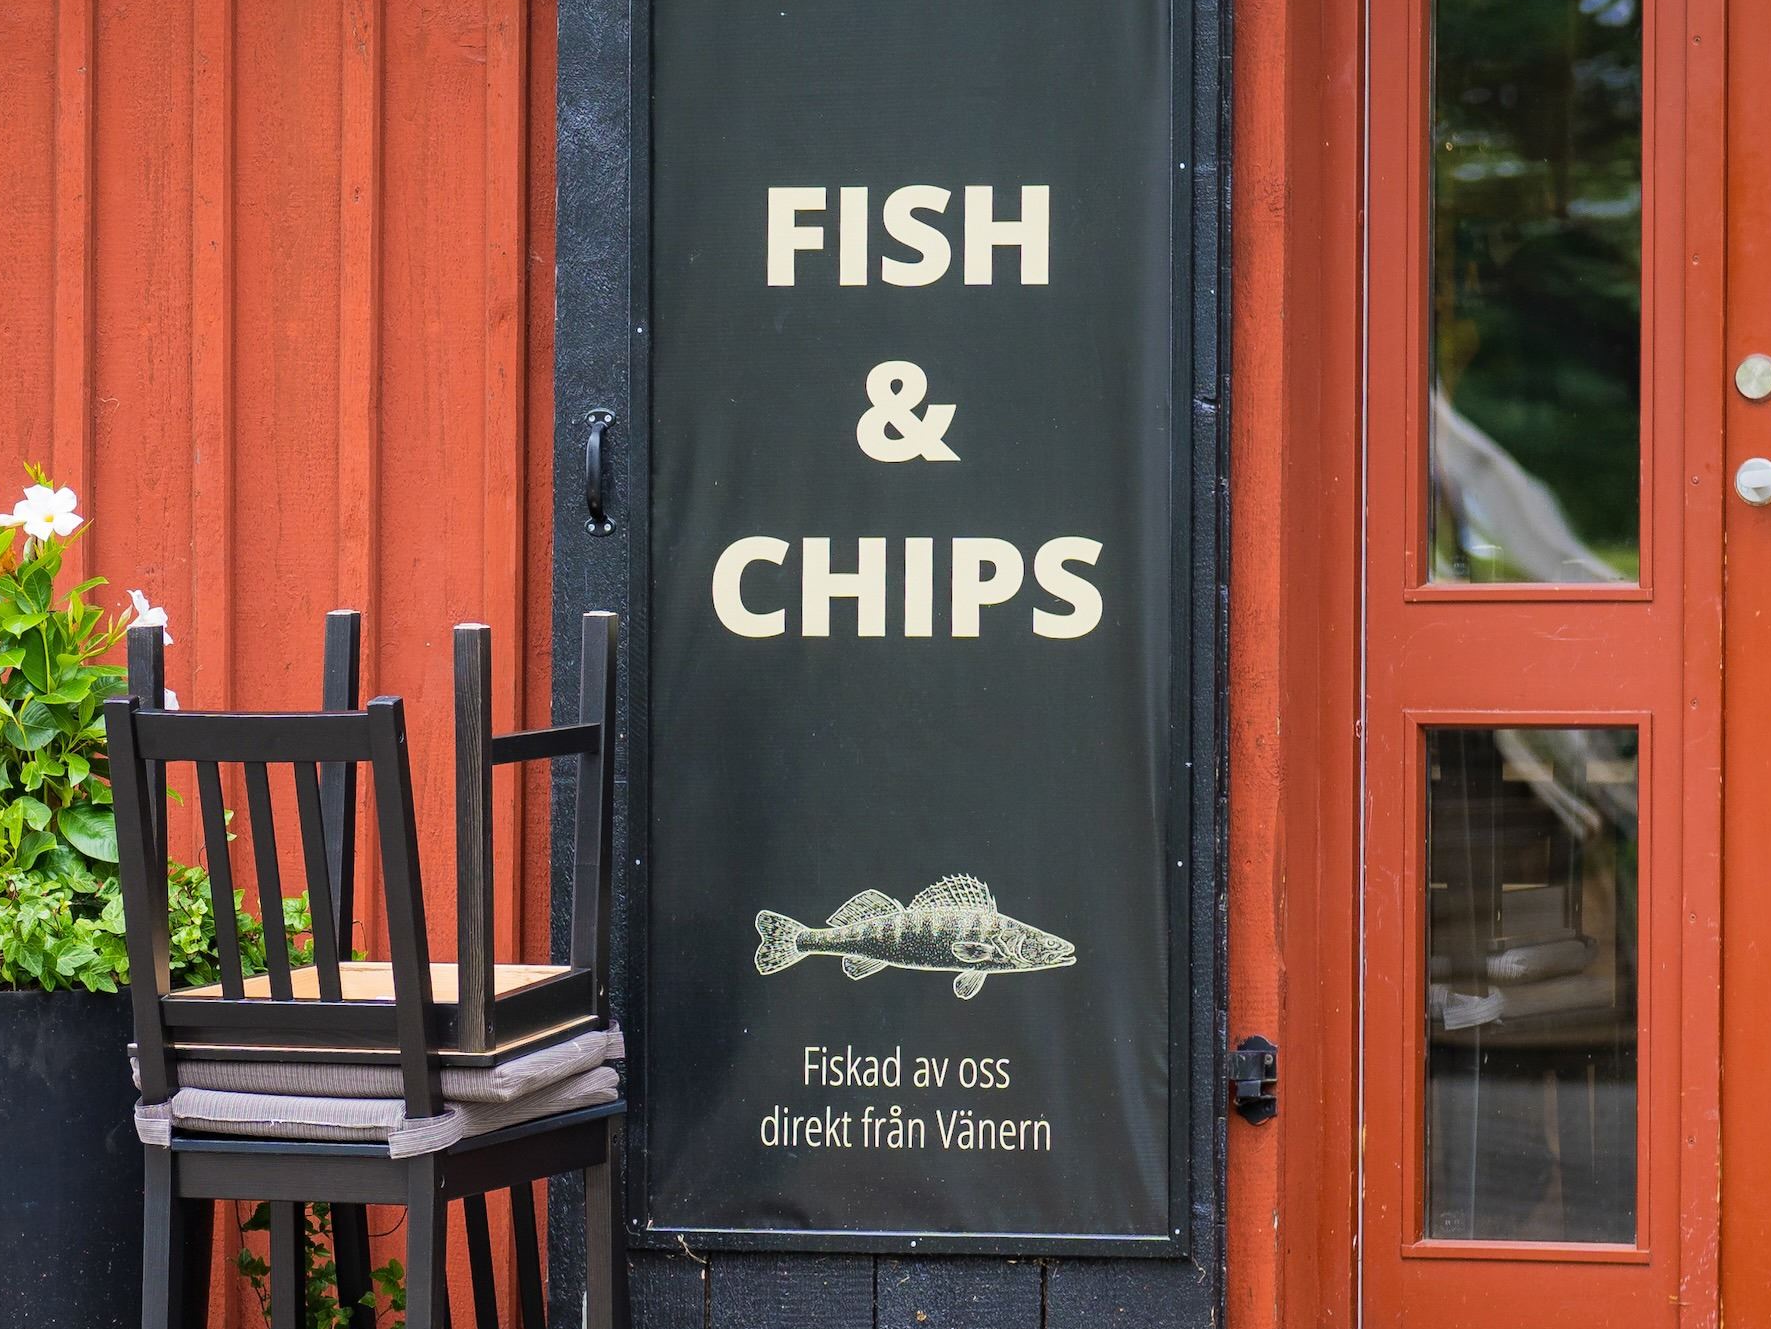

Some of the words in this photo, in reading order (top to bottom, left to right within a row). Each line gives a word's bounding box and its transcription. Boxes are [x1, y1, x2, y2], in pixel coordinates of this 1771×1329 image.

[766, 183, 1051, 288] FISH
[855, 359, 962, 464] &
[711, 534, 1105, 640] CHIPS
[803, 1043, 902, 1089] Fiskad
[912, 1056, 950, 1089] av
[957, 1056, 1011, 1090] oss
[759, 1103, 854, 1149] direkt
[859, 1104, 926, 1150] från
[934, 1108, 1052, 1152] Vänern
